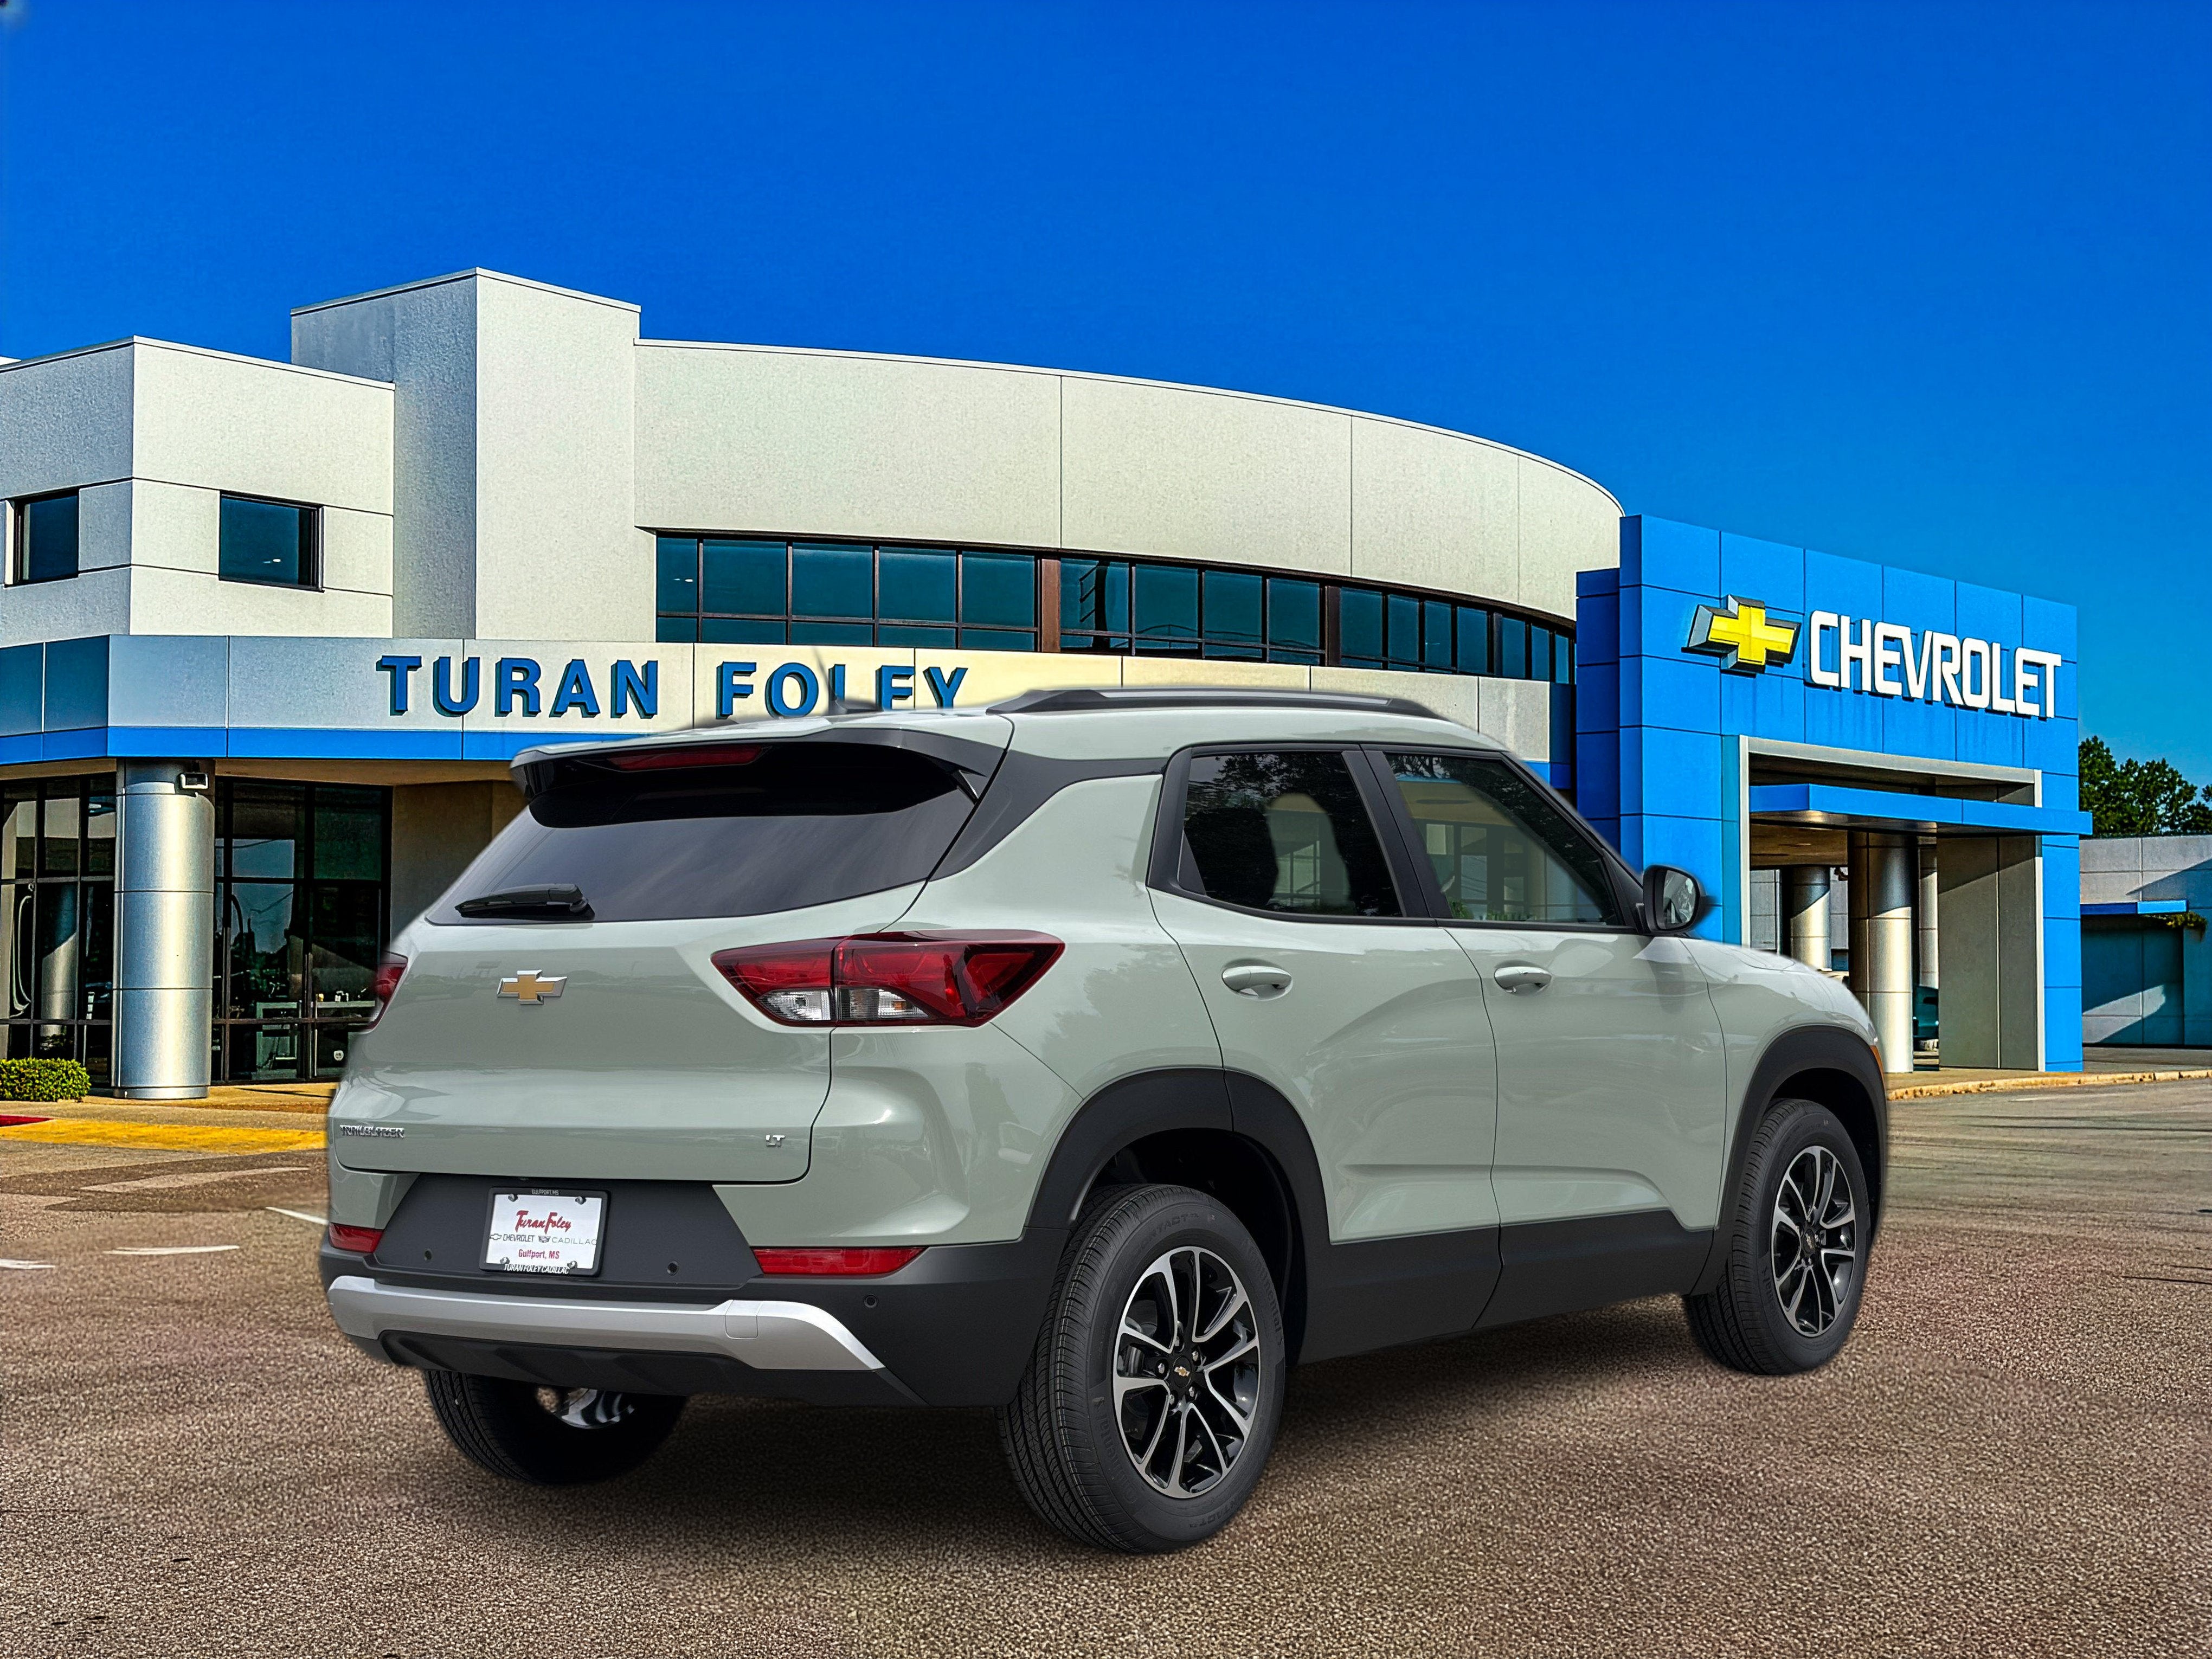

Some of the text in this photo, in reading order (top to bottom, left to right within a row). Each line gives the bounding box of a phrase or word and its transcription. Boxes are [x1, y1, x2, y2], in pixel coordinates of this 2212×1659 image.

[1808, 610, 2062, 720] CHEVROLET
[376, 655, 659, 719] TURAN
[766, 1134, 785, 1147] LT
[515, 1210, 571, 1234] Turan Foley
[503, 1233, 597, 1245] CHEVROLET CADILLAC
[518, 1249, 560, 1259] Gulfport, MS
